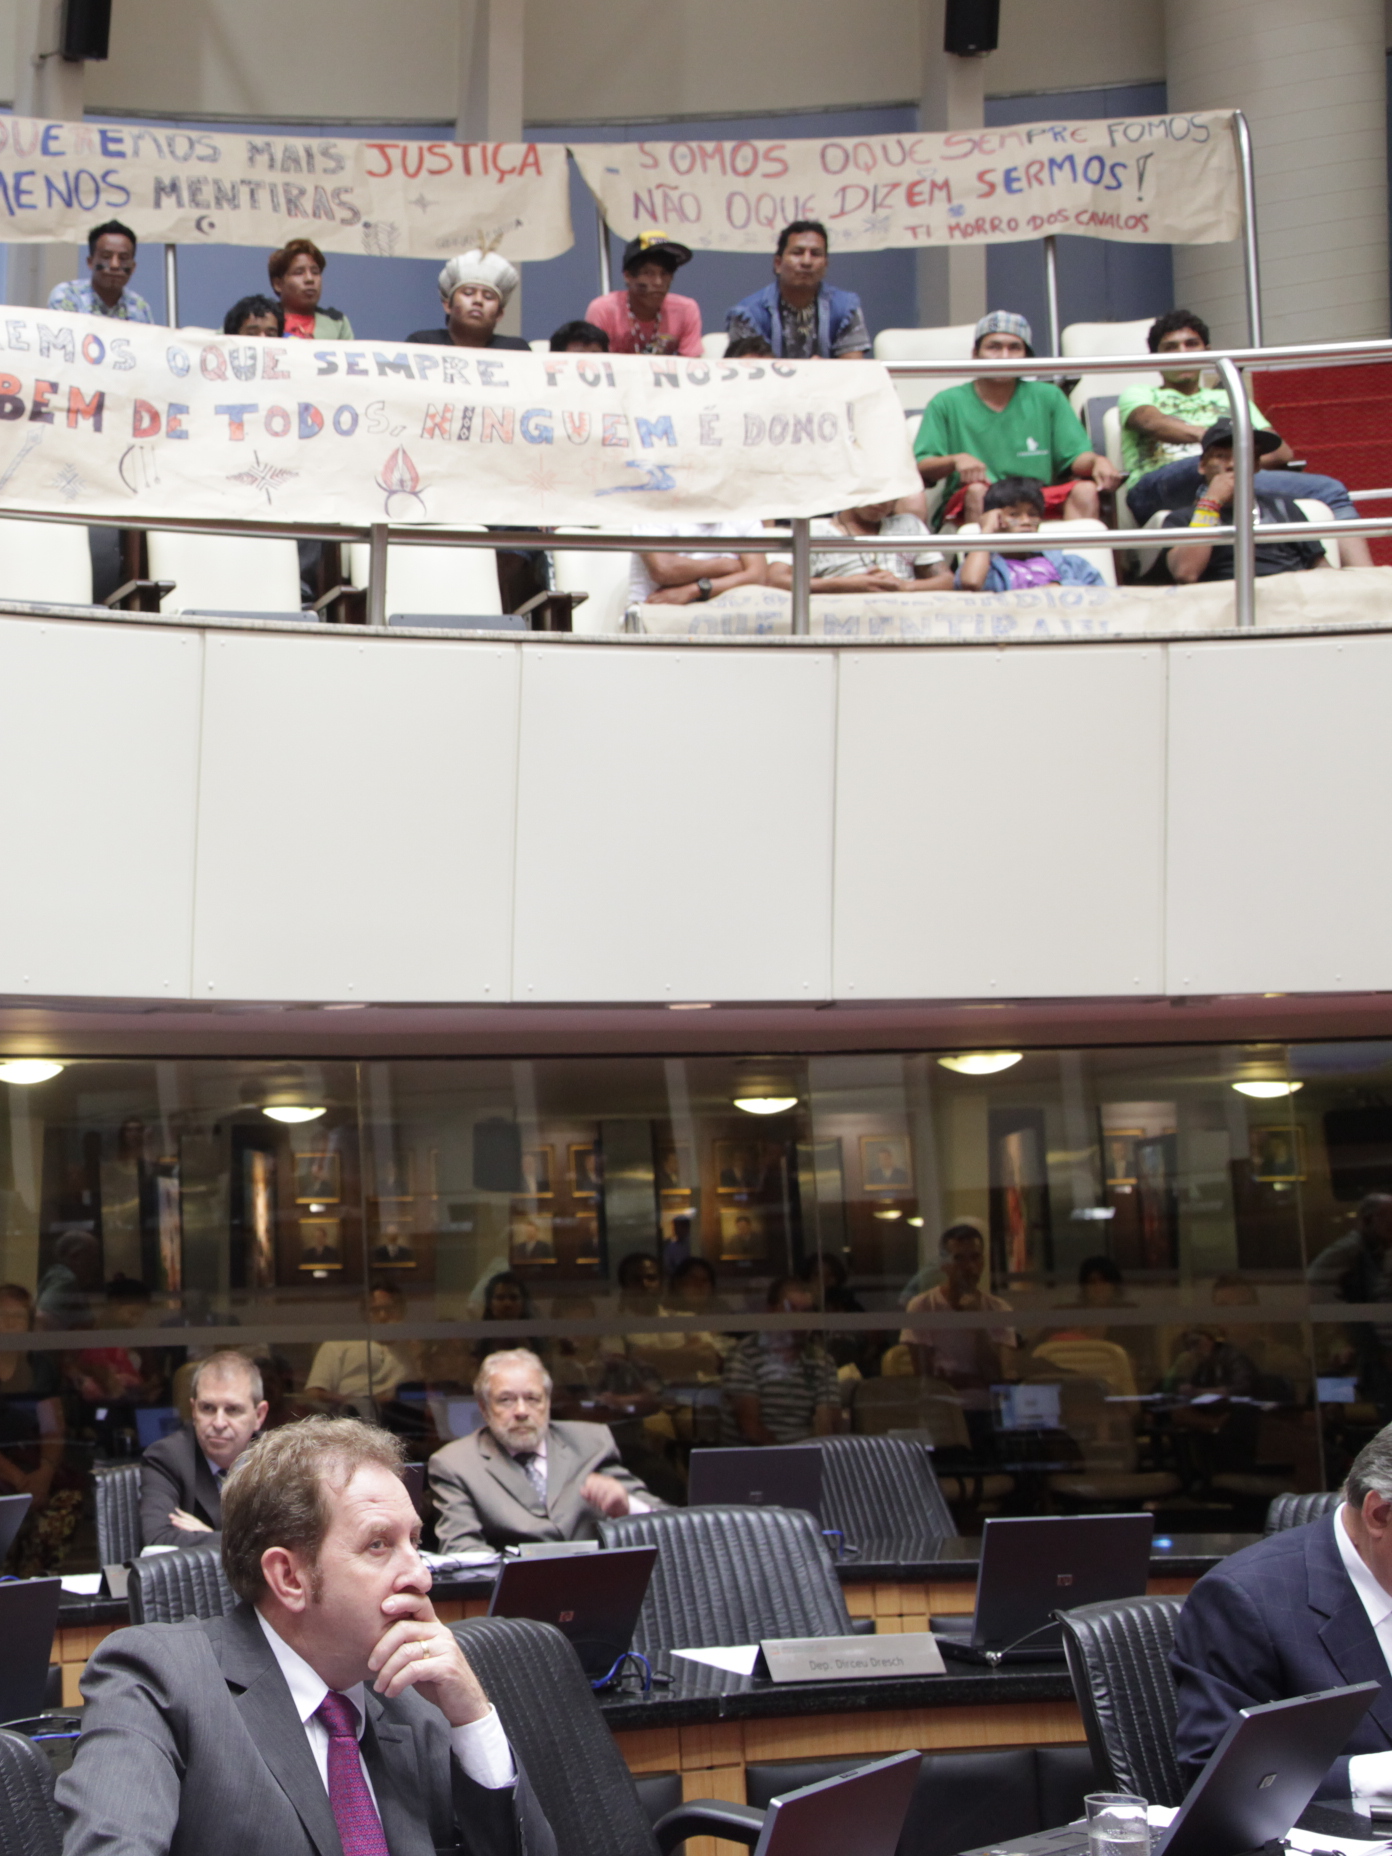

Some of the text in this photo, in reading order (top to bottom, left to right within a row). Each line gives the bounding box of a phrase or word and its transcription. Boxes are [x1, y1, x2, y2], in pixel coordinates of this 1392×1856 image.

[246, 139, 346, 174] MAIS
[365, 142, 543, 184] JUSTIÇA
[637, 140, 790, 178] SOMOS
[939, 126, 1088, 161] SEMPRE
[1107, 114, 1210, 148] FOMOS
[632, 184, 702, 224] NÃO
[828, 177, 953, 219] DIZEM
[904, 208, 1150, 239] TI MORRO DOS CAVALOS
[313, 351, 510, 387] SEMPRE
[544, 359, 617, 388] FOI
[651, 359, 798, 389] NOSSO
[131, 399, 190, 440] DE
[420, 402, 678, 449] NINGUEM
[698, 404, 723, 447] É
[809, 1656, 904, 1671] Dep. Dirceu Dresch
